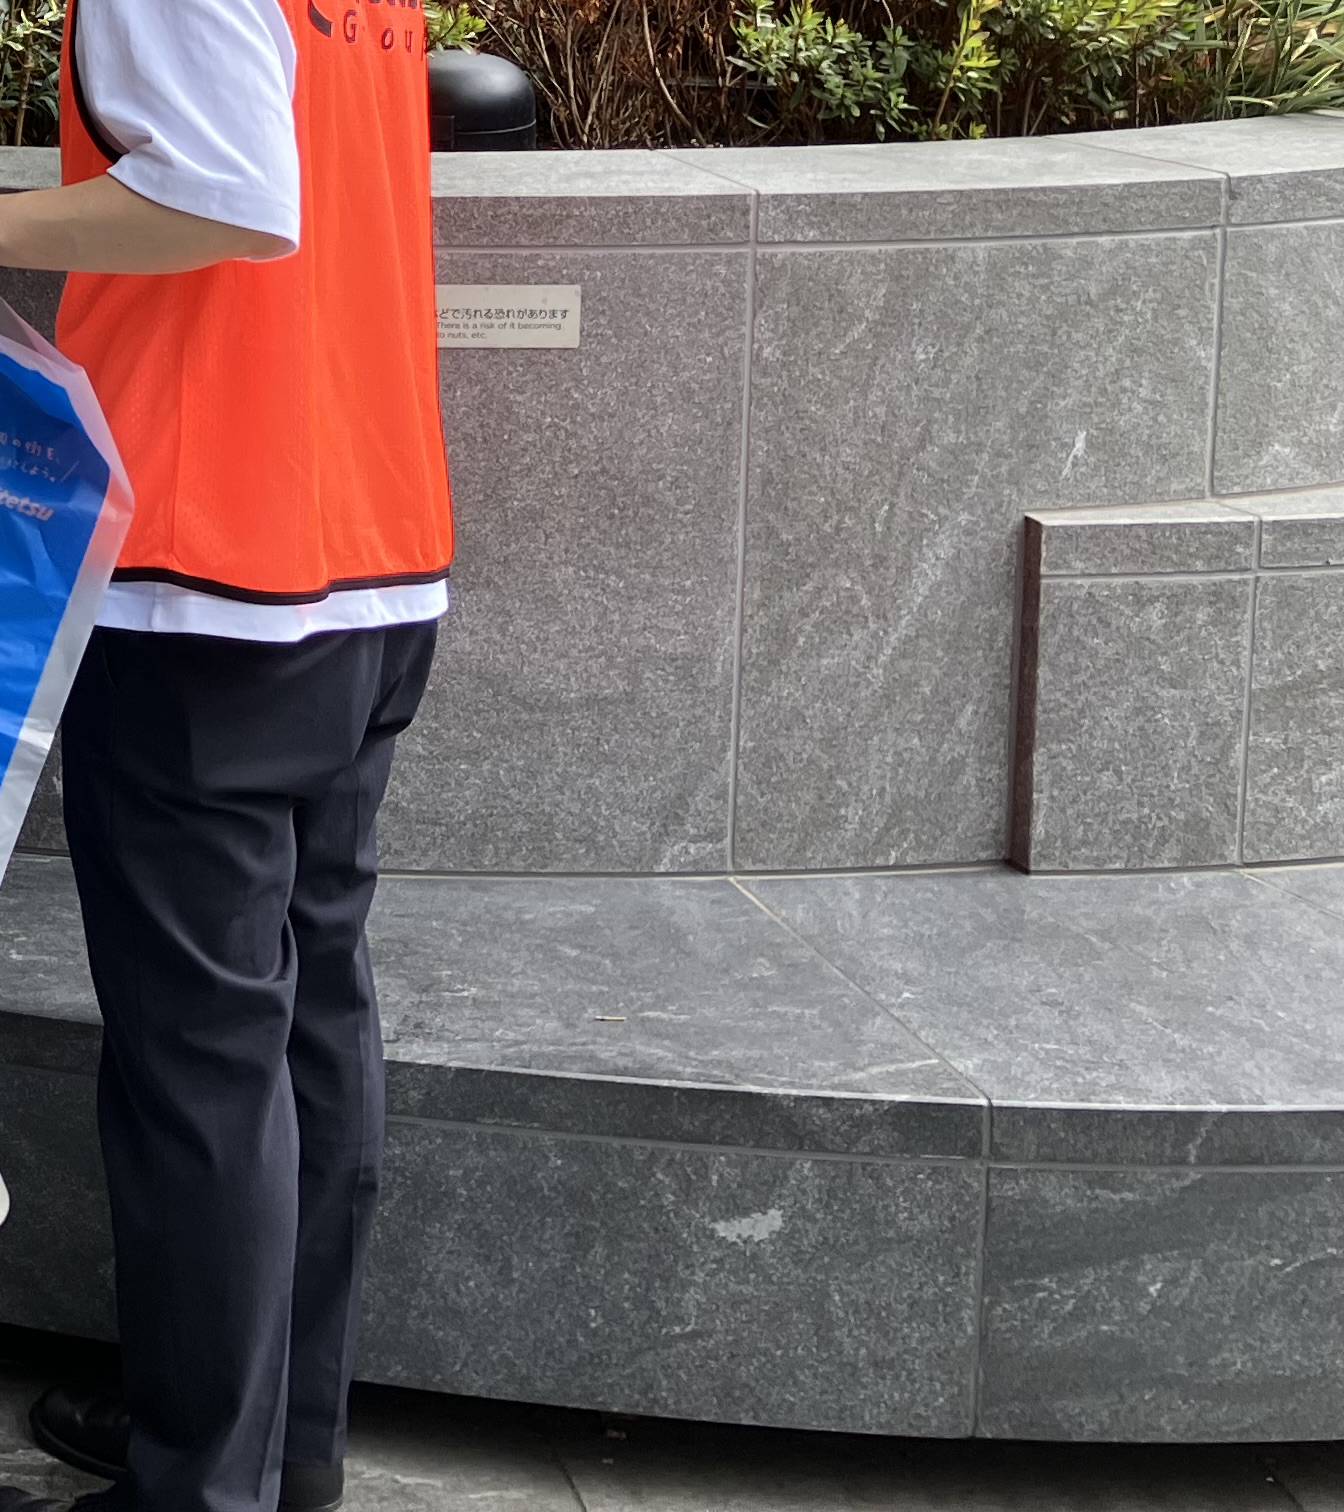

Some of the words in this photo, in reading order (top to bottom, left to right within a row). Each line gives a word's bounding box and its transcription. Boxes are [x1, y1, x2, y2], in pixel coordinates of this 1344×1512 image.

[435, 308, 569, 320] どで汚れる恐れがあります
[462, 322, 469, 330] is
[480, 322, 495, 330] risk
[497, 322, 507, 330] of
[509, 322, 515, 330] it
[517, 322, 562, 331] becoming
